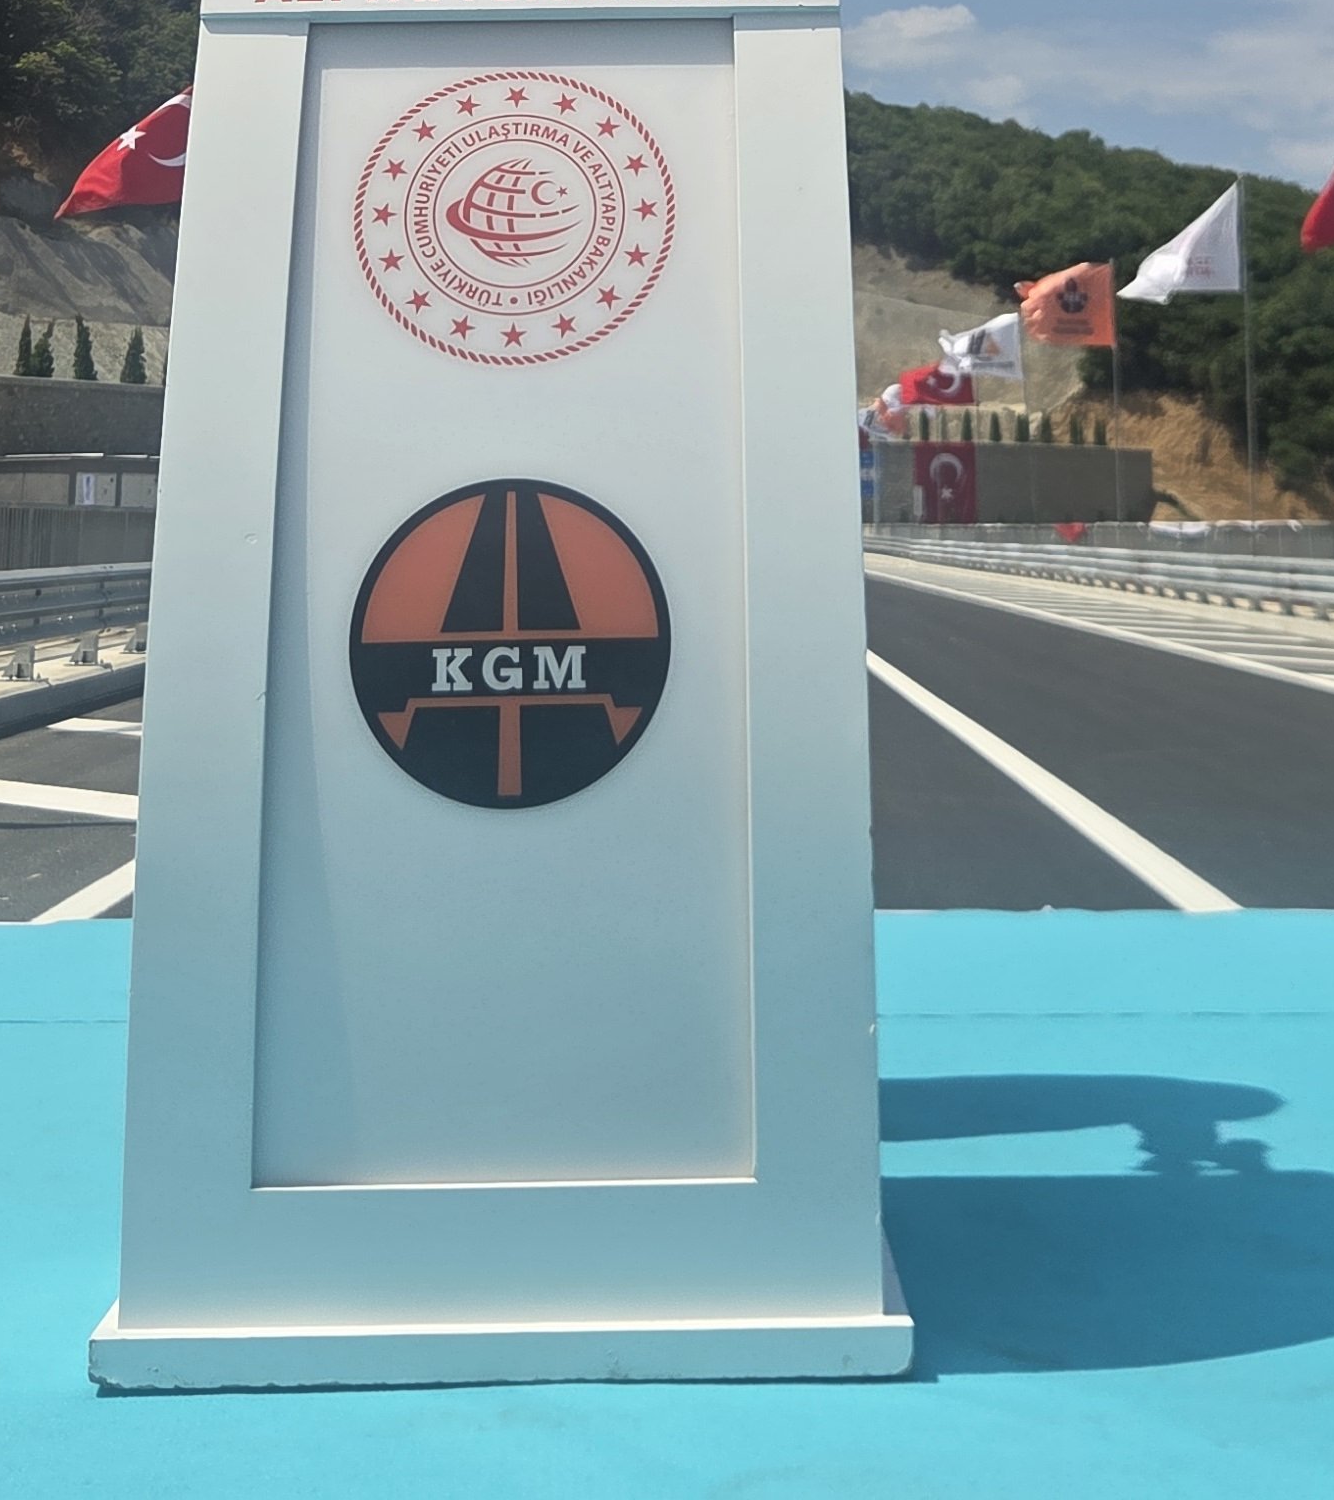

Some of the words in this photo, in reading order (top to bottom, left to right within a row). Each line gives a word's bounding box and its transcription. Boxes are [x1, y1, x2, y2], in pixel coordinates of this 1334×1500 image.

[461, 122, 569, 148] ULAŞTIRMA
[573, 140, 595, 163] VE
[413, 140, 462, 259] CUMHURİYETİ
[588, 161, 616, 232] ALTYAPI
[429, 258, 504, 307] TÜRKİYE
[527, 234, 612, 306] BAKANLIĞI
[431, 645, 586, 691] KGM
